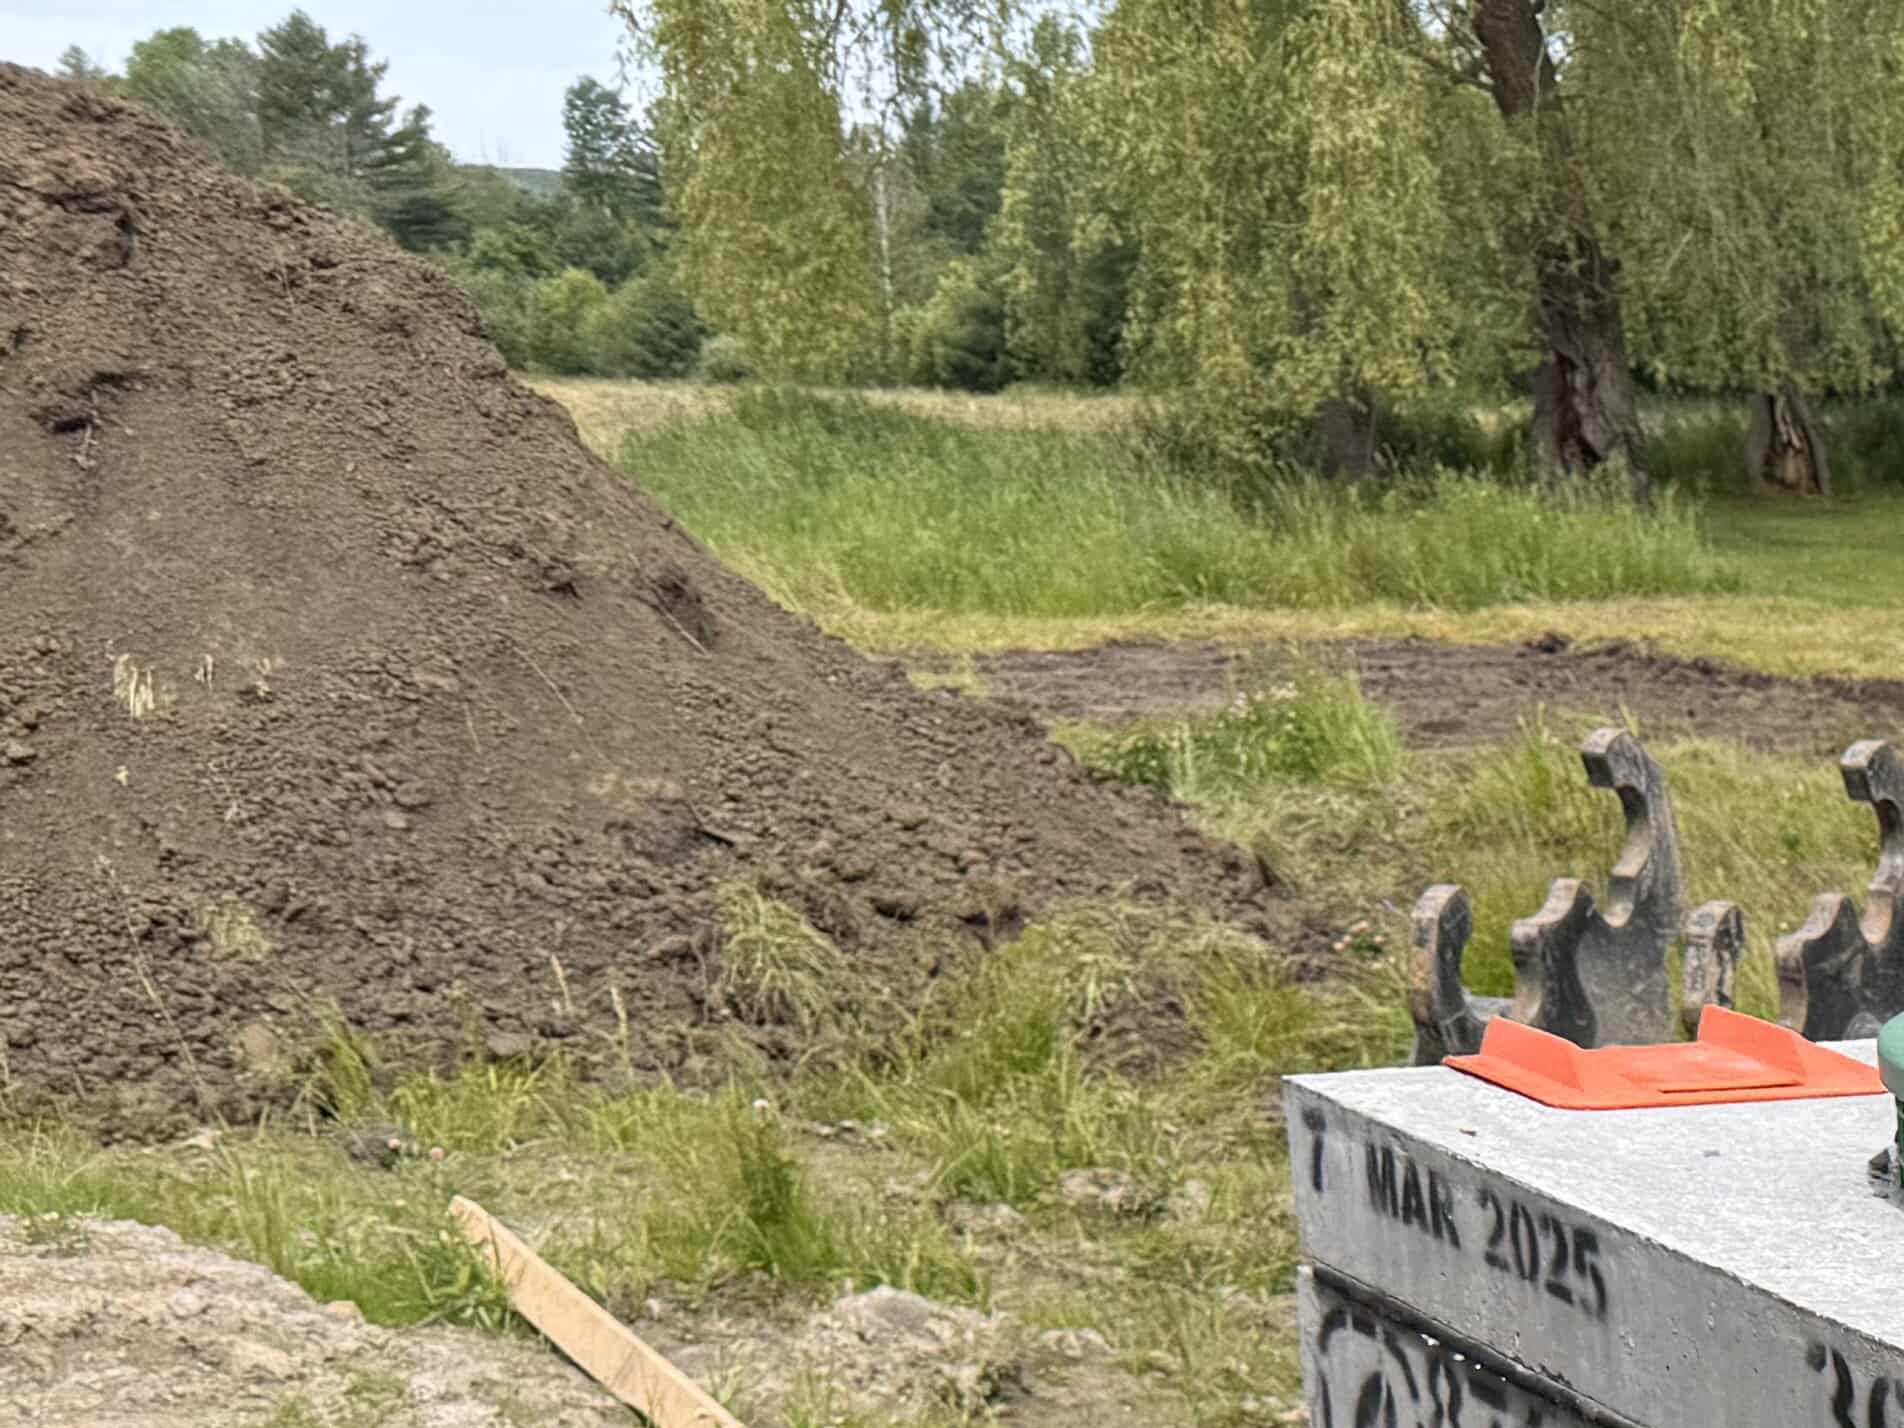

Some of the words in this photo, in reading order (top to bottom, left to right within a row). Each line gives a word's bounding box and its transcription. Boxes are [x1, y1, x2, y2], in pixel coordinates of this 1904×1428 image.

[1302, 1105, 1327, 1194] 7
[1364, 1141, 1461, 1250] MAR
[1478, 1186, 1608, 1325] 2025
